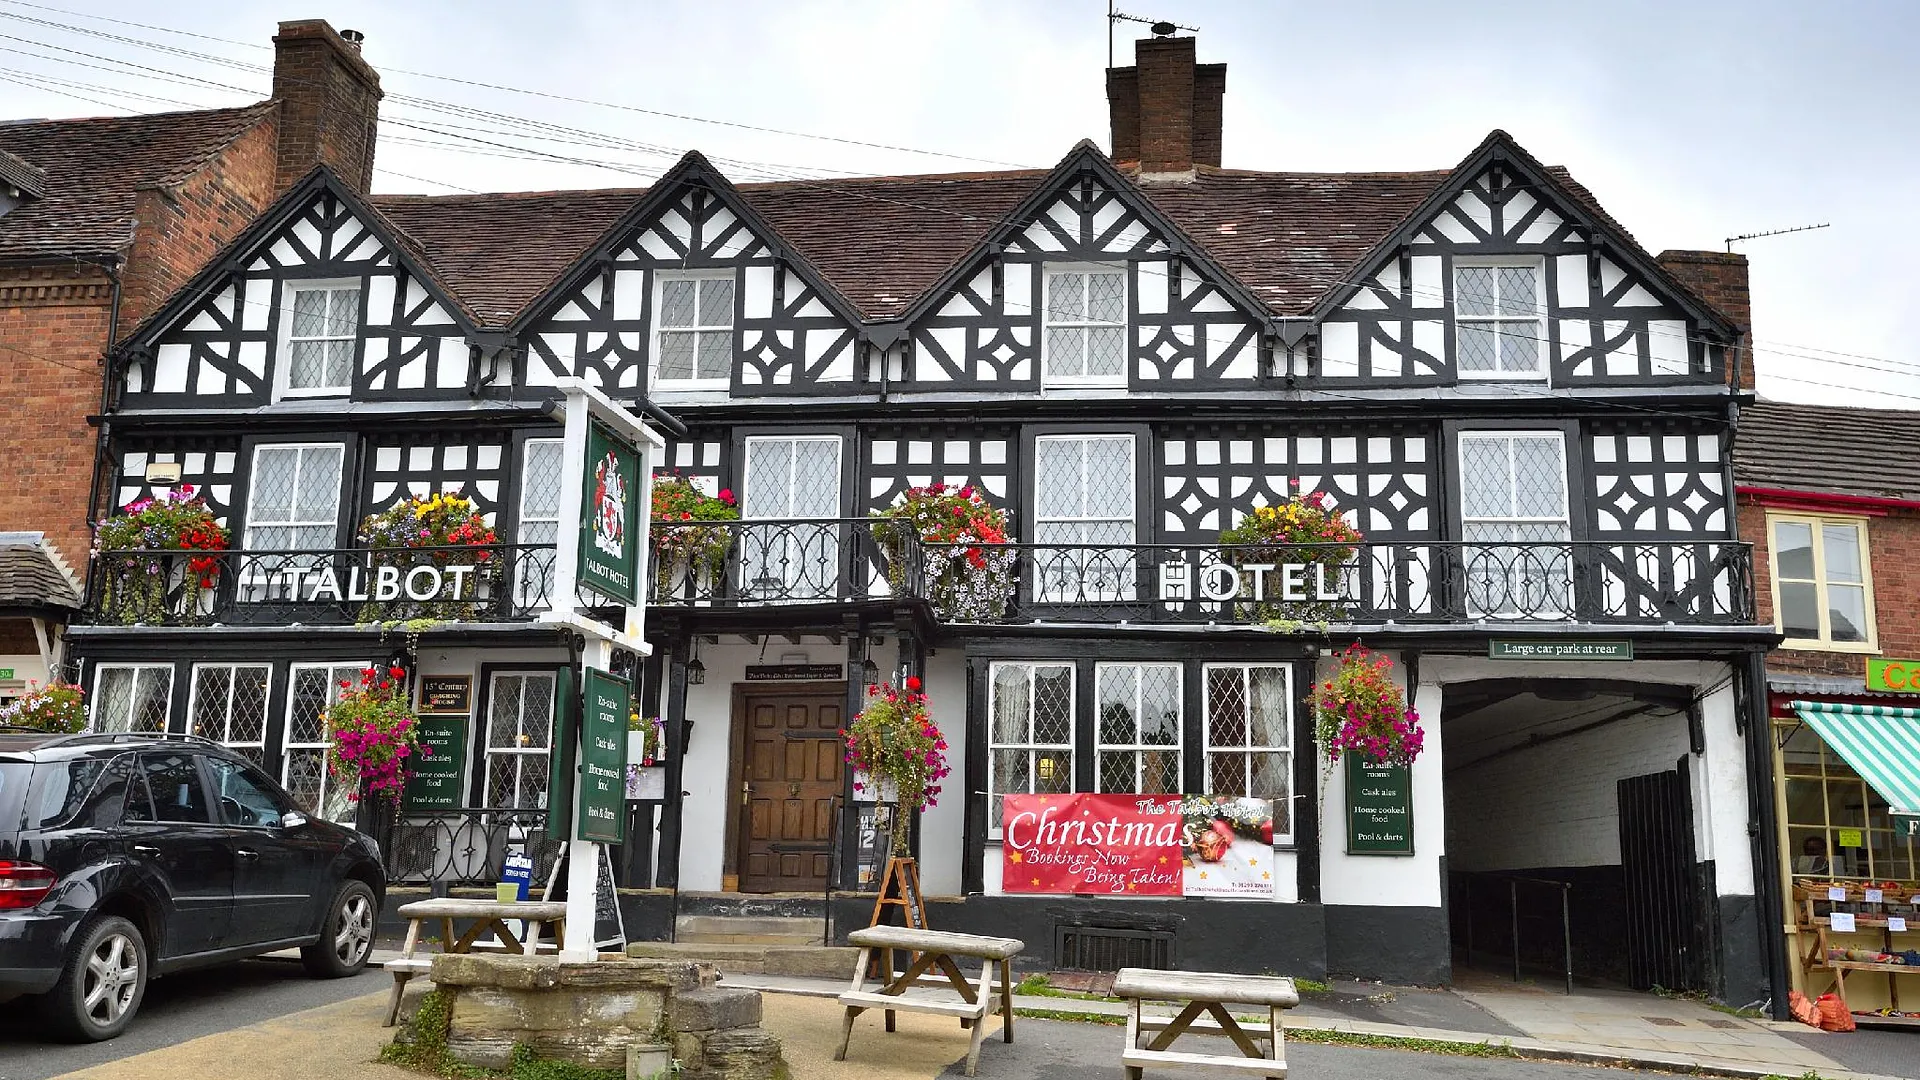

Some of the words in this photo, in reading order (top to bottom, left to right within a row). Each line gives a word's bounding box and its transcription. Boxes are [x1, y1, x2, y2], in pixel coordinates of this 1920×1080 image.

[586, 557, 609, 579] TALBOT
[609, 568, 629, 589] HOTEL
[282, 565, 475, 603] TALBOT
[1159, 562, 1340, 601] HOTEL
[1503, 643, 1535, 655] Large
[1536, 645, 1554, 654] car
[1556, 643, 1580, 655] park
[1582, 645, 1593, 654] at
[1595, 645, 1618, 654] rear
[438, 682, 468, 692] Century
[425, 727, 453, 737] En-suite
[433, 771, 458, 779] cooked
[426, 779, 442, 787] food
[1361, 788, 1380, 796] Cask
[1381, 788, 1396, 796] ales
[435, 796, 453, 804] darts
[599, 808, 604, 818] &
[1135, 798, 1165, 815] The
[1167, 797, 1219, 816] Talbot
[1220, 802, 1265, 819] Hotel
[1378, 806, 1405, 814] cooked
[1371, 814, 1388, 823] food
[1008, 806, 1197, 850] Christmas
[1358, 832, 1374, 841] Pool
[1375, 833, 1382, 841] &
[1383, 832, 1403, 841] darts
[1026, 846, 1089, 874] Bookings
[1091, 848, 1130, 865] Now
[1083, 865, 1127, 893] Being
[1129, 865, 1180, 885] Taken!
